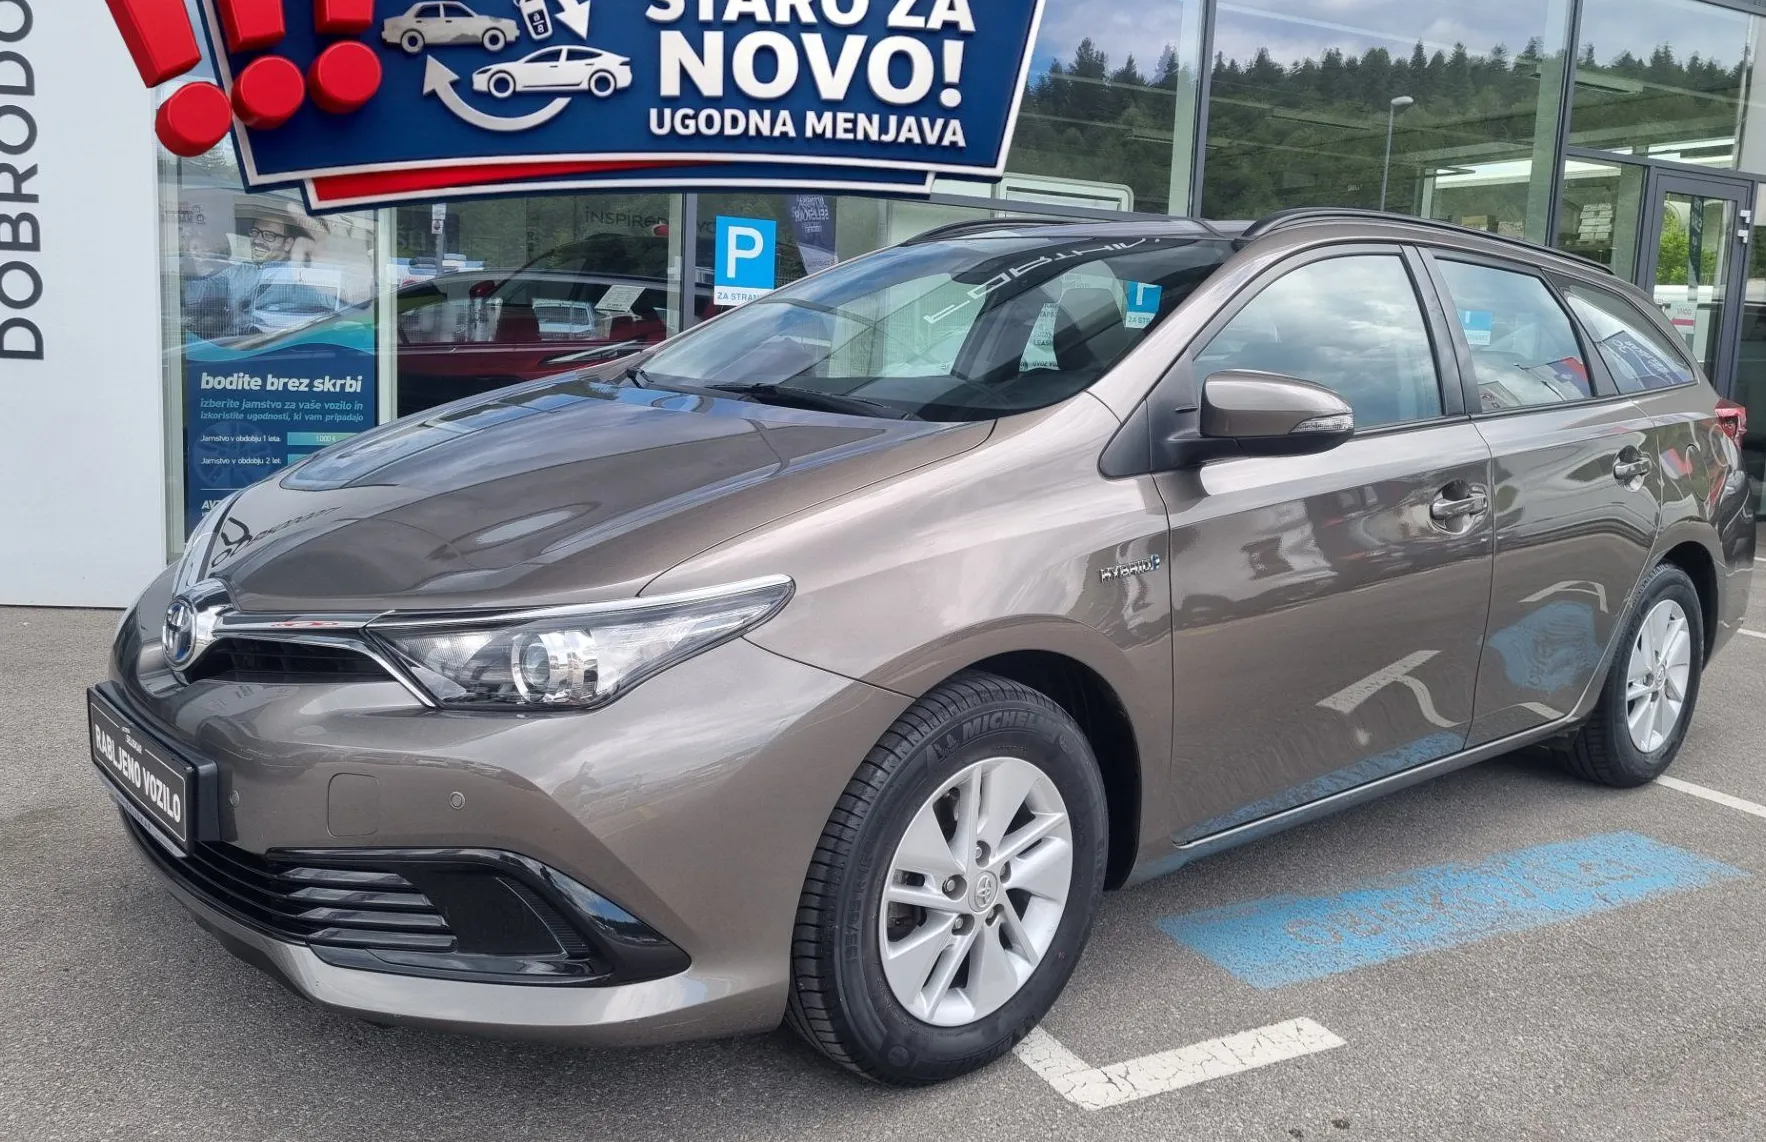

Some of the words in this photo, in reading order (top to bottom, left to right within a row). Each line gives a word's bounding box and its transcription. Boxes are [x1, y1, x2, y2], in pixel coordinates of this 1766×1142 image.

[726, 225, 764, 278] P
[717, 292, 729, 300] ZA
[200, 372, 262, 391] bodite
[266, 374, 310, 392] brez
[312, 375, 363, 393] skrbi
[241, 399, 282, 410] jamstvo
[284, 401, 296, 409] za
[299, 400, 321, 410] vaše
[324, 401, 352, 410] vozilo
[354, 401, 363, 410] in
[293, 412, 302, 421] ki
[305, 413, 323, 421] vam
[325, 413, 364, 422] pripadajo
[235, 435, 262, 443] obdobju
[238, 457, 264, 466] obdobju
[1099, 558, 1152, 583] HYBRID
[95, 724, 141, 788] RABLJENO
[142, 767, 181, 823] VOZILO
